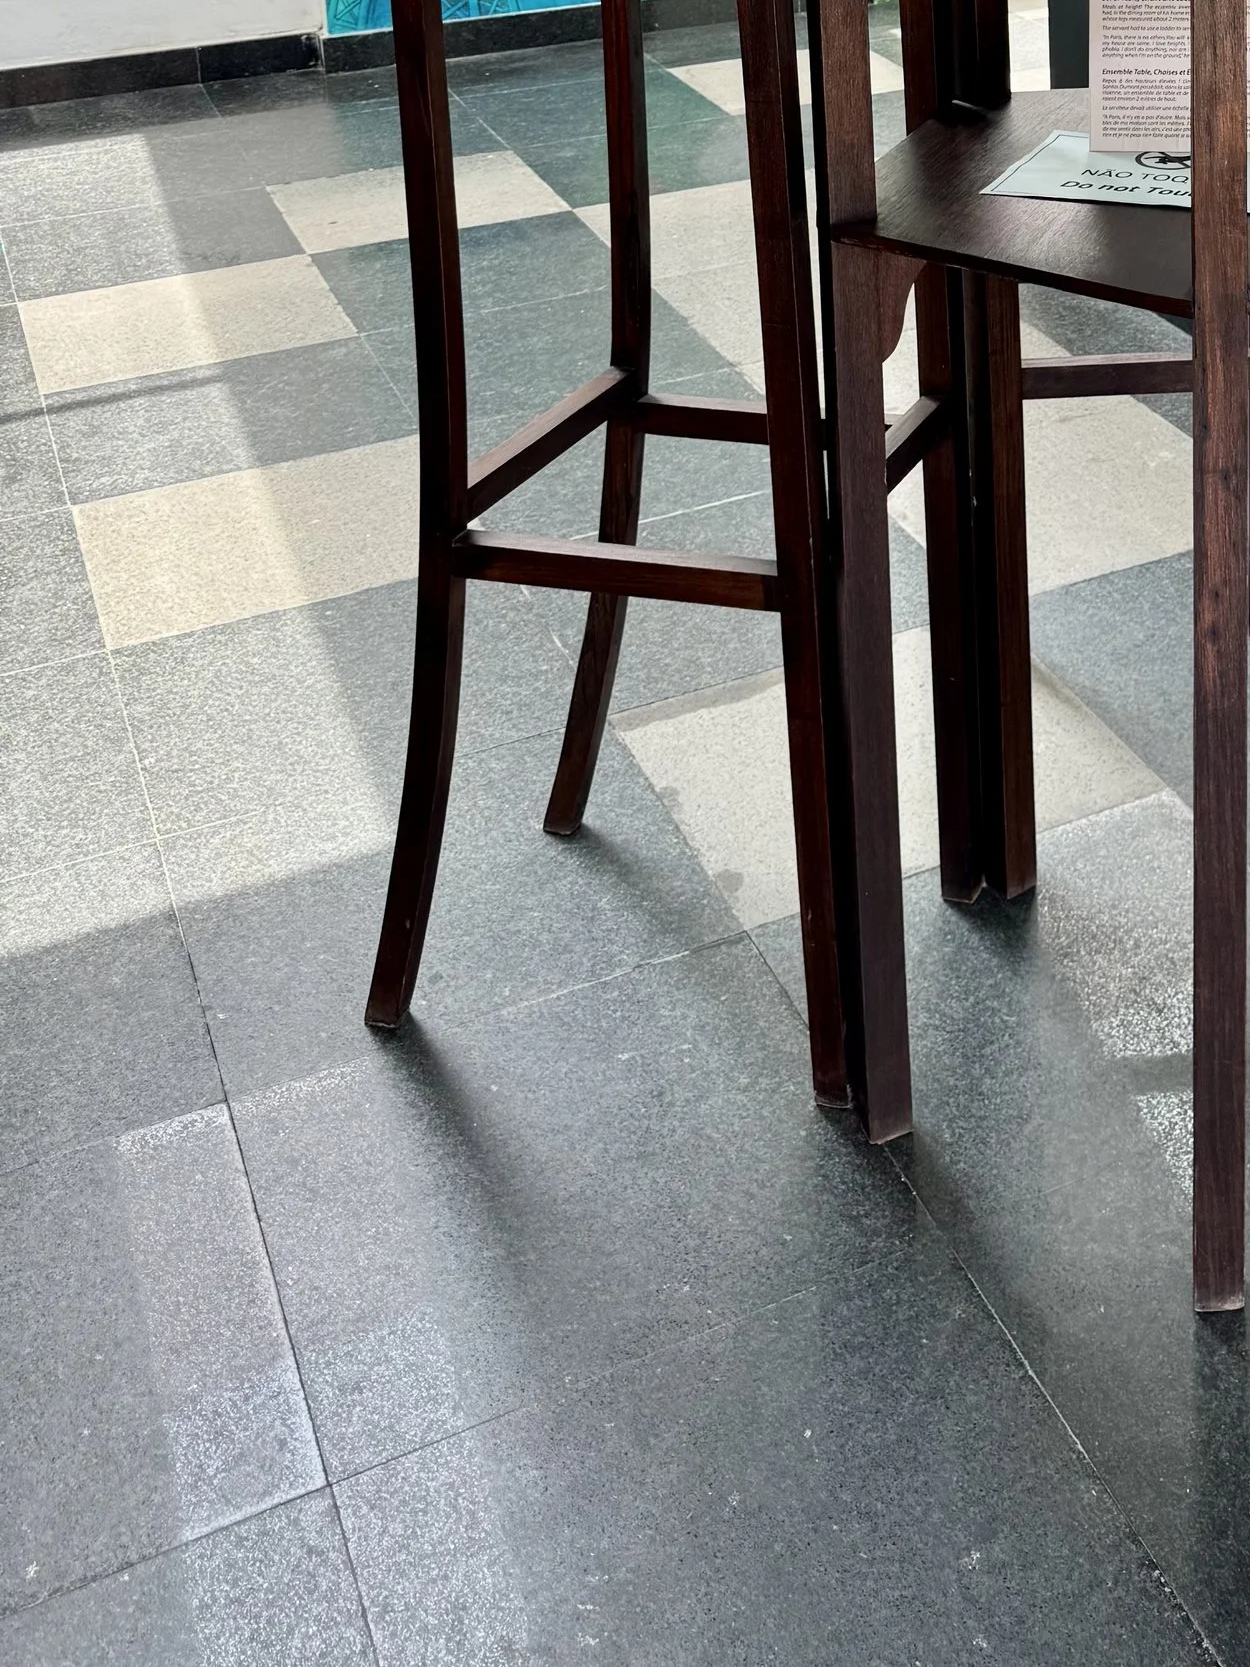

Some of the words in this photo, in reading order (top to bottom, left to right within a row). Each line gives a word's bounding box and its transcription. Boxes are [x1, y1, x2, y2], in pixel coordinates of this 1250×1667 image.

[1081, 168, 1135, 180] NÃO
[1142, 172, 1189, 184] TOQ
[1060, 179, 1092, 190] Do
[1098, 183, 1141, 193] not
[1146, 186, 1191, 197] Tou
